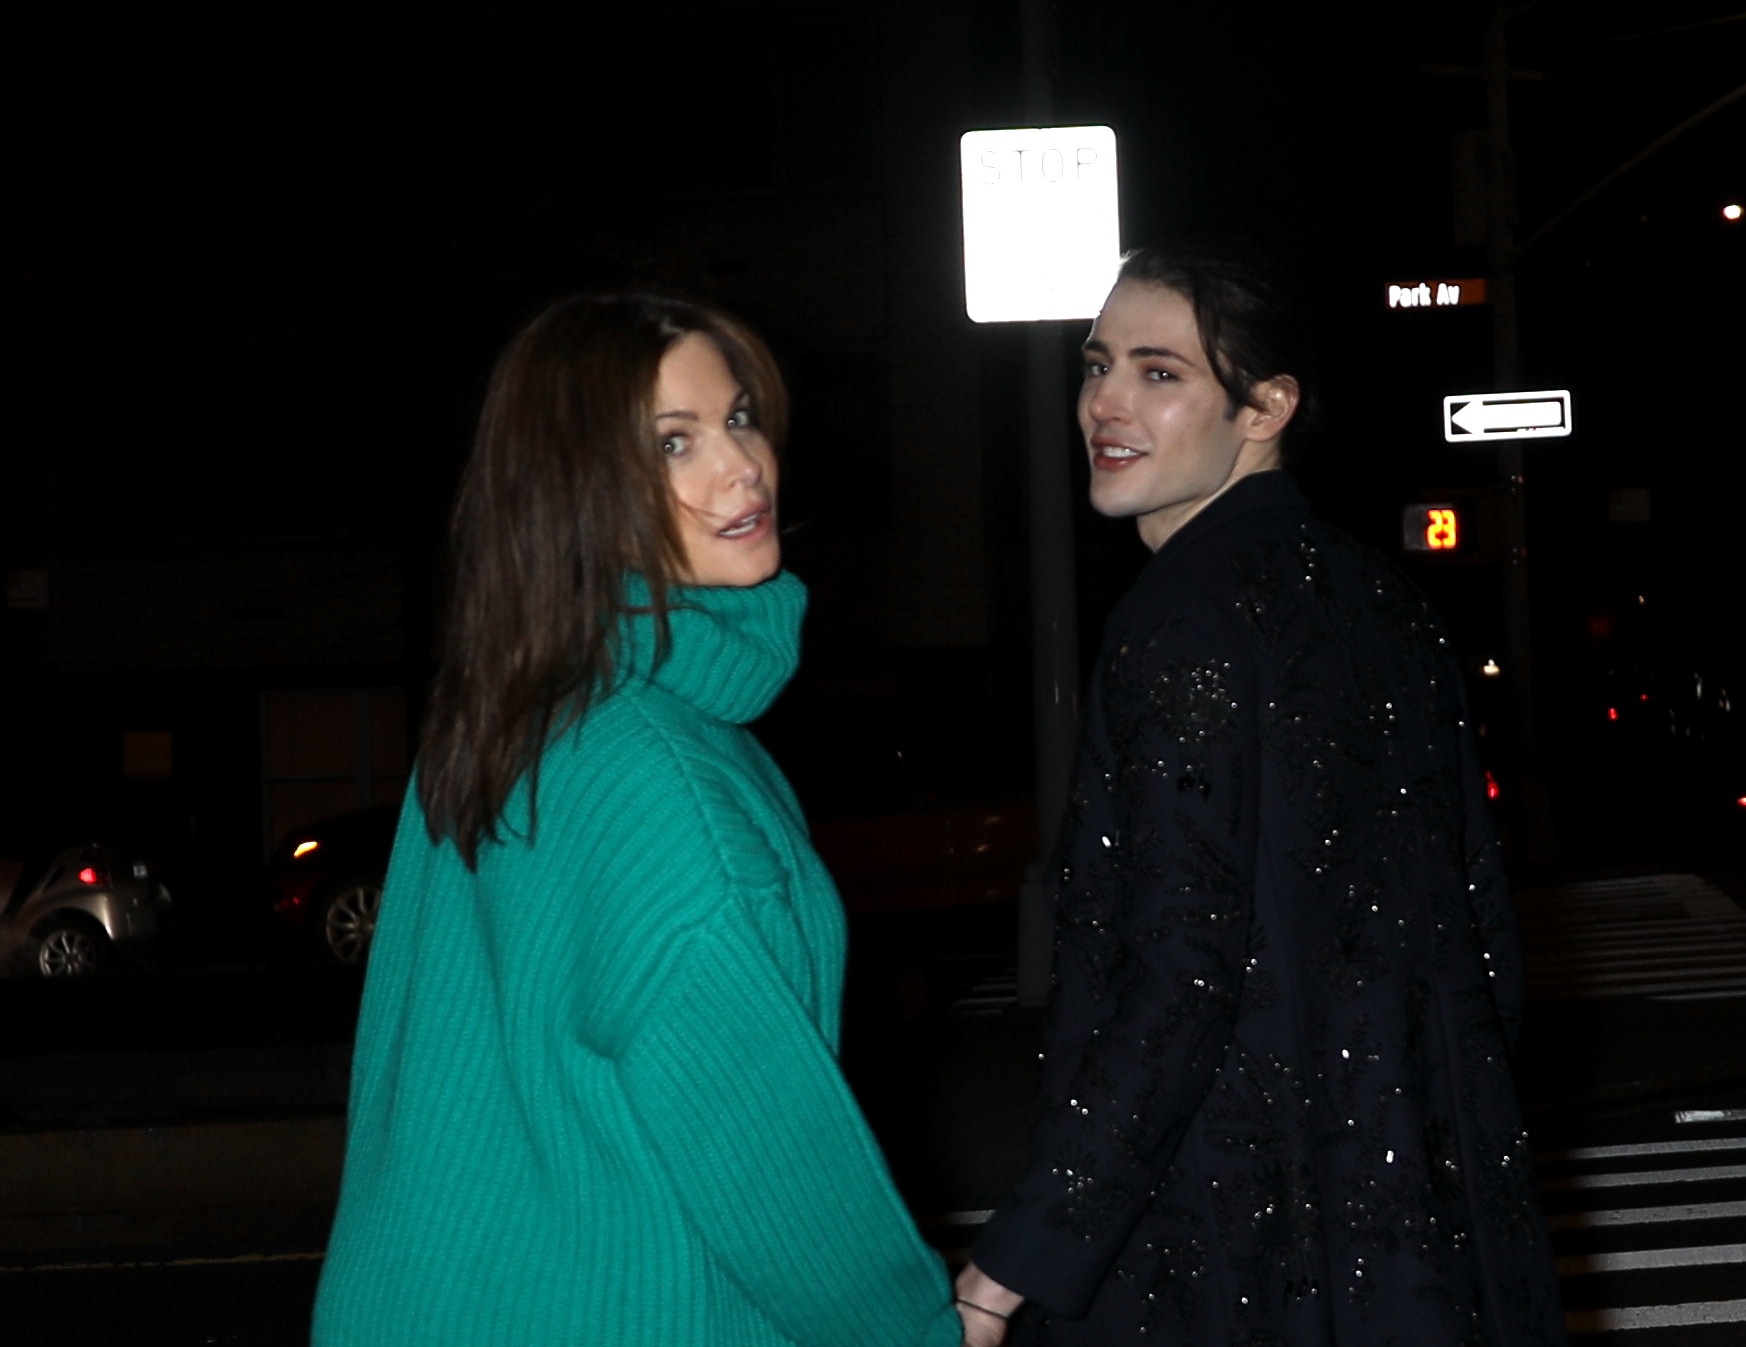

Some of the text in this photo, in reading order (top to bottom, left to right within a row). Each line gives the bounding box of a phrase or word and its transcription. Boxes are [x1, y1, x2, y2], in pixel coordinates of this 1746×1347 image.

[979, 147, 1099, 185] STOP
[1389, 283, 1459, 307] Park Av
[1427, 509, 1456, 549] 23
